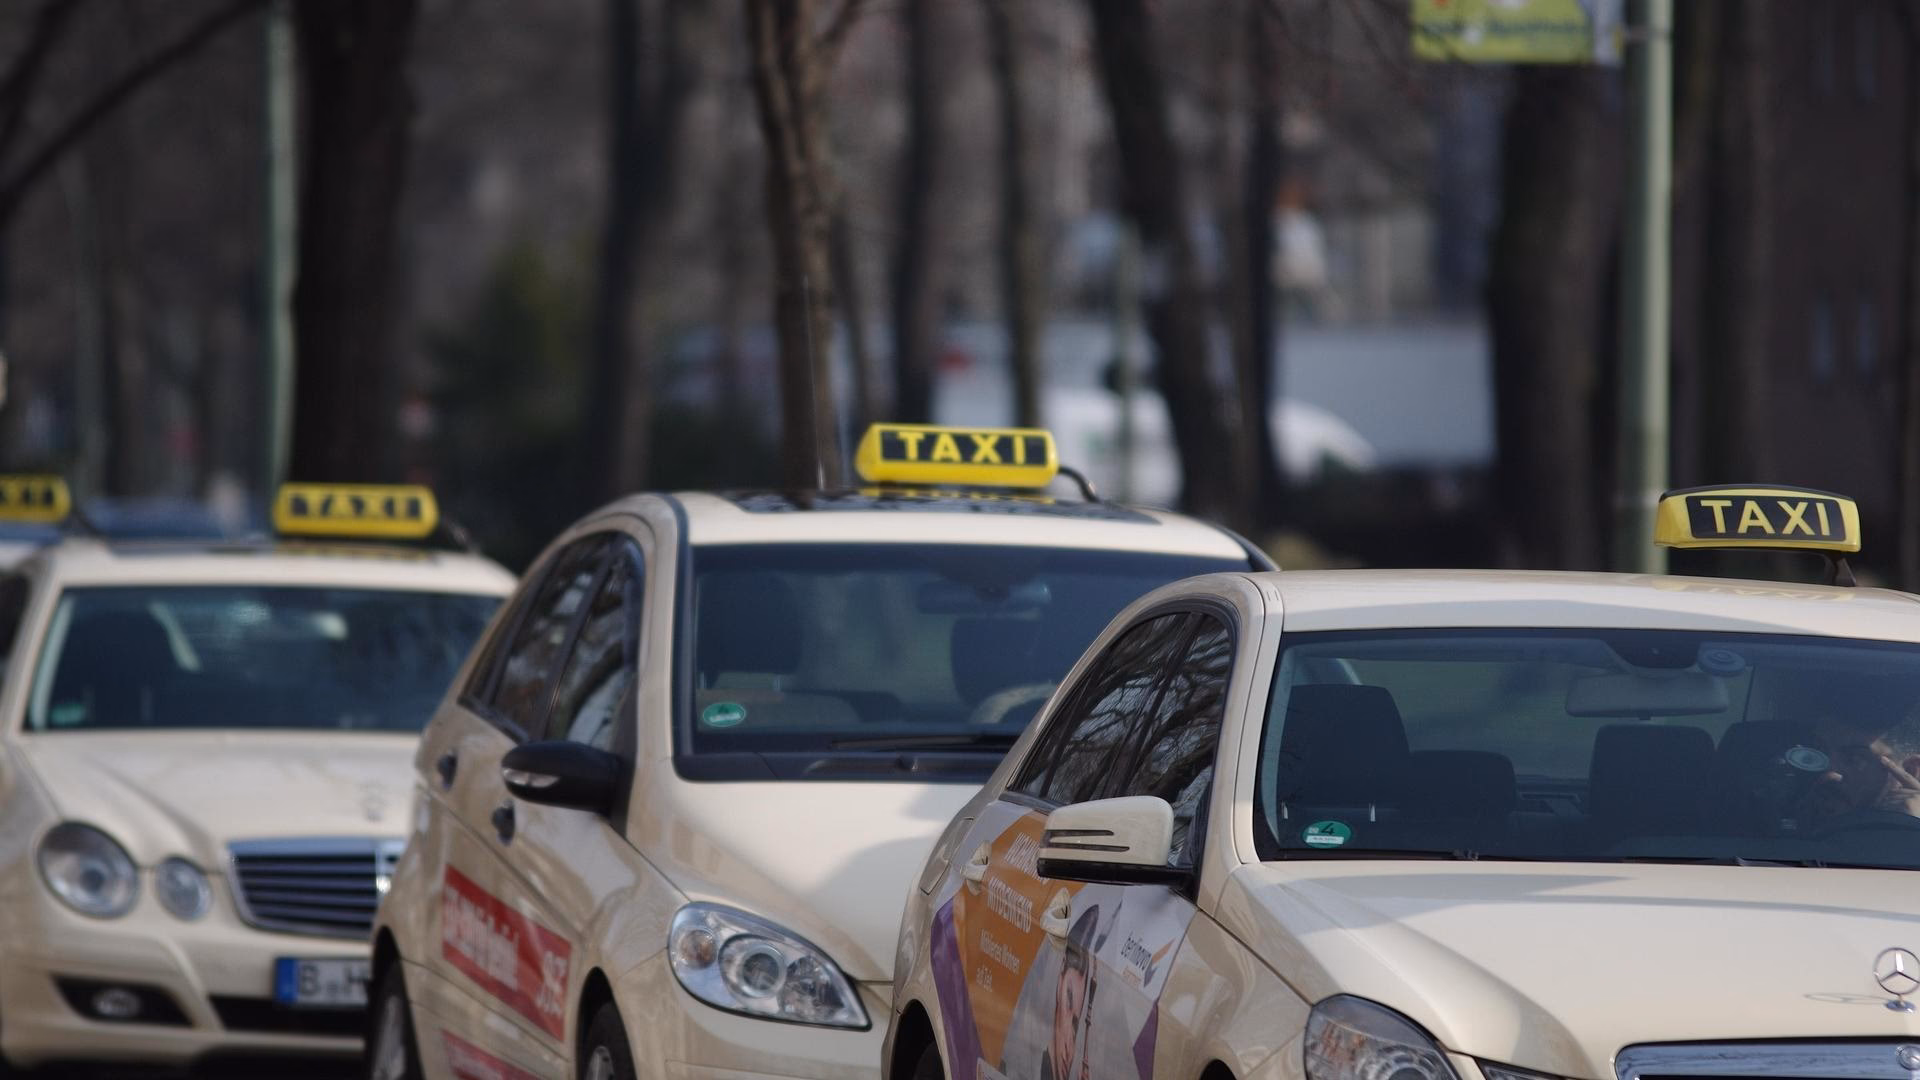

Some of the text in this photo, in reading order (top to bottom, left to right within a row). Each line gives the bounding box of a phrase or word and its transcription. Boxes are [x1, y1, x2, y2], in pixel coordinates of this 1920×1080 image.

[898, 432, 1026, 465] TAXI
[296, 494, 407, 518] TAXI
[1700, 499, 1830, 537] TAXI
